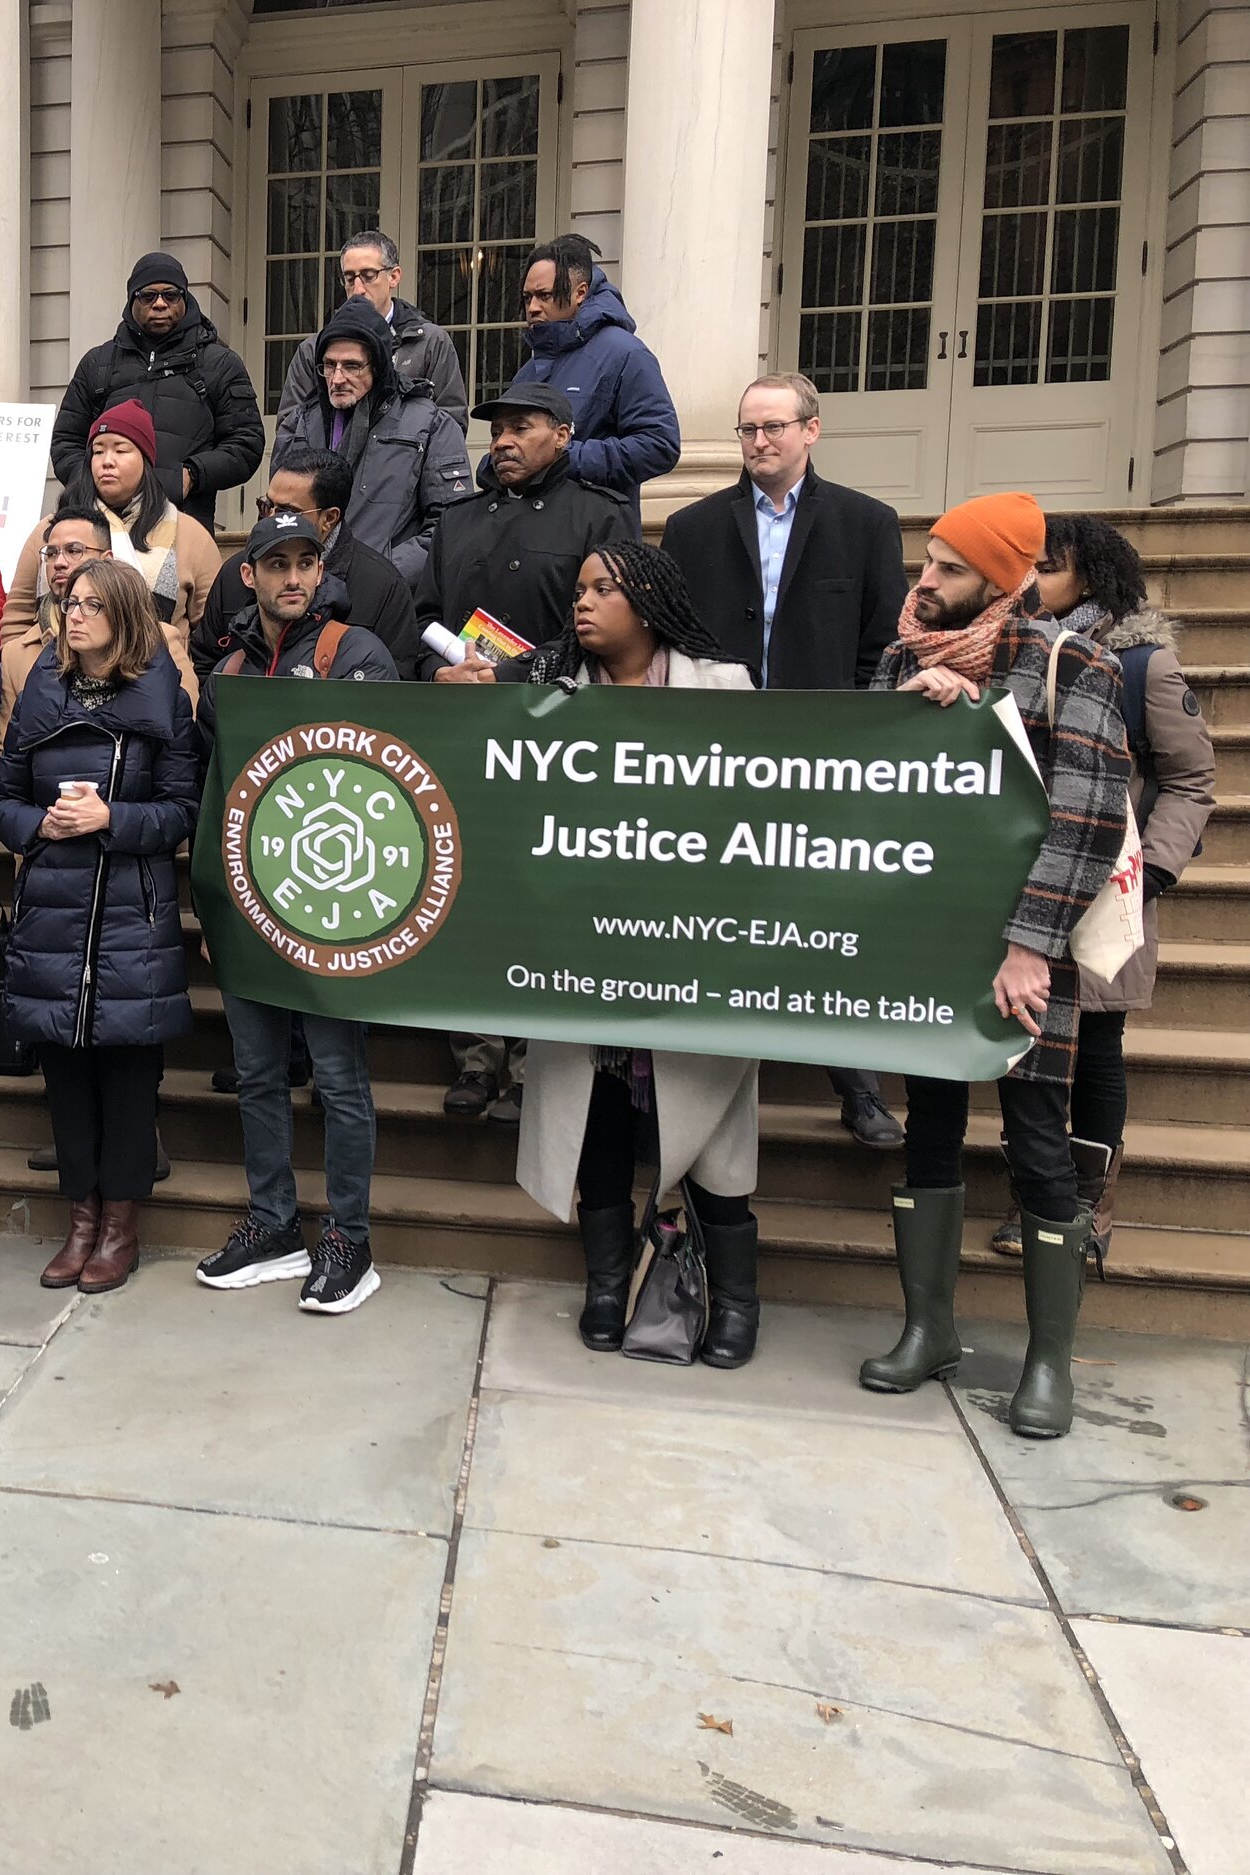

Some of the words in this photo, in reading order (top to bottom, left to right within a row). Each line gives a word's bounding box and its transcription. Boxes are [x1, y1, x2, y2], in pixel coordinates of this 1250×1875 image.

[17, 417, 42, 427] FOR
[247, 736, 294, 787] NEW
[300, 728, 377, 757] YORK
[381, 745, 437, 796] CITY
[485, 738, 598, 783] NYC
[613, 741, 1003, 796] Environmental
[261, 835, 285, 858] 19
[382, 845, 410, 868] 91
[531, 815, 707, 863] Justice
[719, 822, 934, 875] Alliance
[227, 808, 320, 968] ENVIRONMENTAL
[327, 927, 419, 971] JUSTICE
[415, 822, 455, 933] ALLIANCE
[592, 915, 859, 957] www.NYC-EJA.org
[506, 964, 546, 990] On
[552, 968, 596, 994] the
[601, 978, 699, 1004] ground
[729, 985, 780, 1011] and
[787, 990, 816, 1014] at
[823, 990, 871, 1018] the
[877, 995, 954, 1024] table
